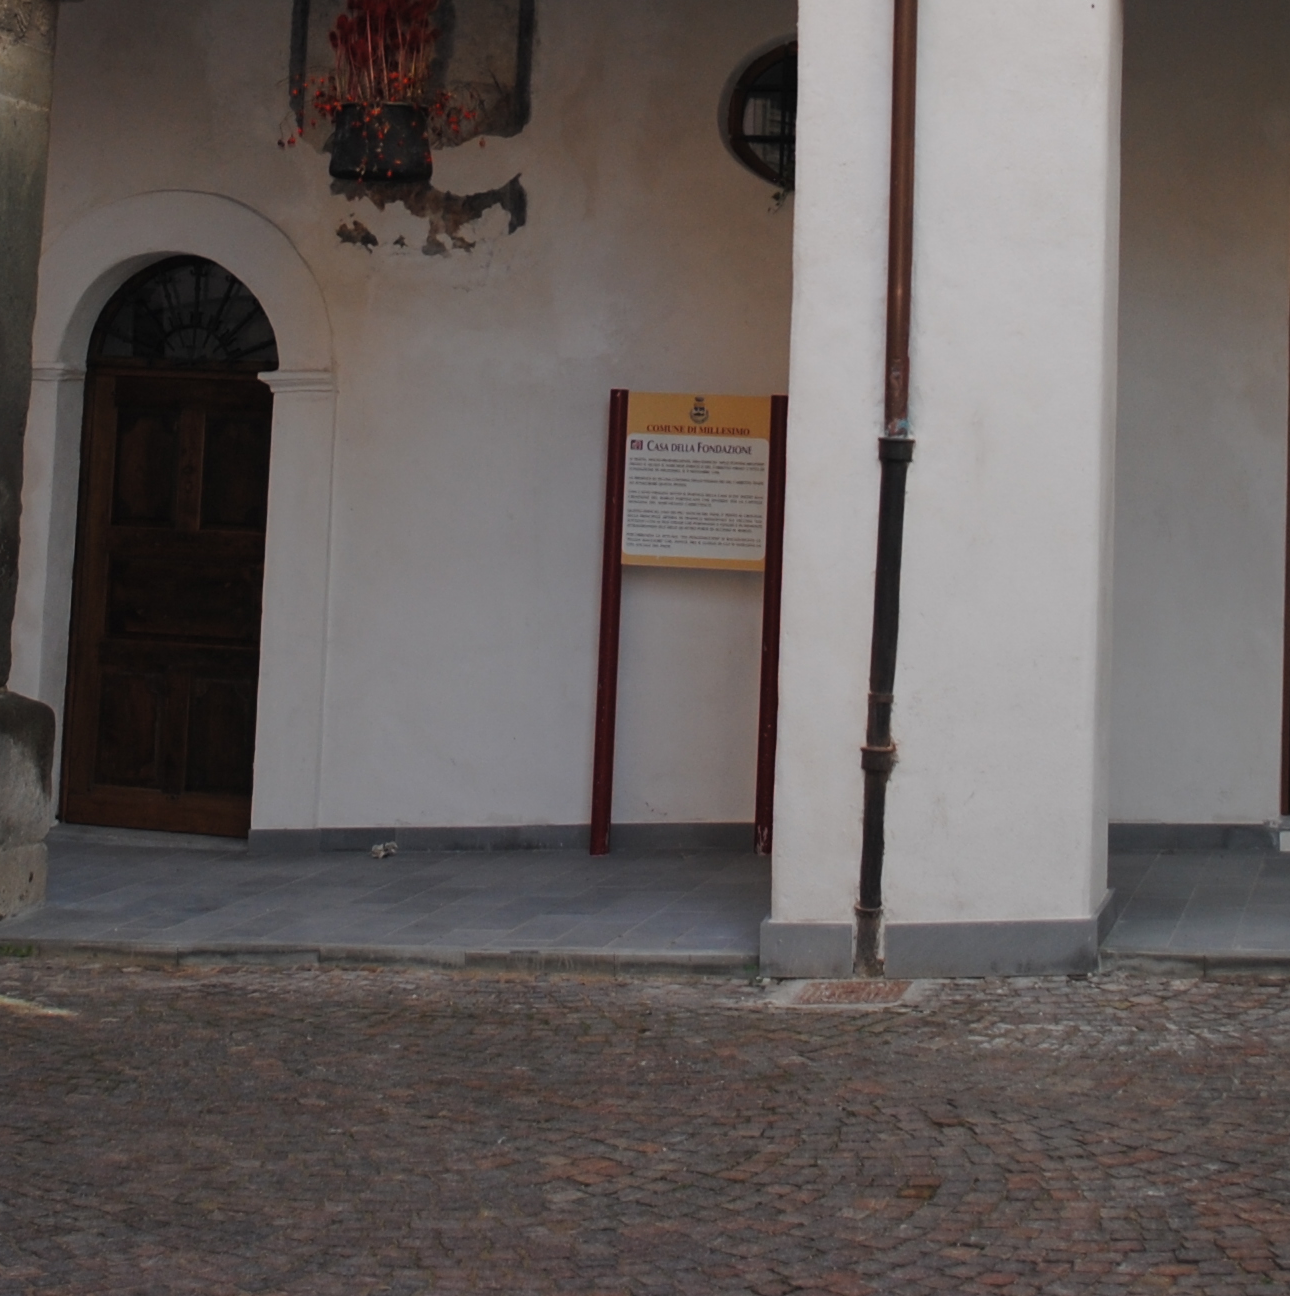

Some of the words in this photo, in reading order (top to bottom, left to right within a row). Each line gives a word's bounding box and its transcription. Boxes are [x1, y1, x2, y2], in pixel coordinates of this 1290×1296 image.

[646, 424, 684, 433] COMUNE
[687, 425, 697, 434] DI
[699, 426, 751, 436] MILLESIMO
[671, 443, 695, 453] DELLA
